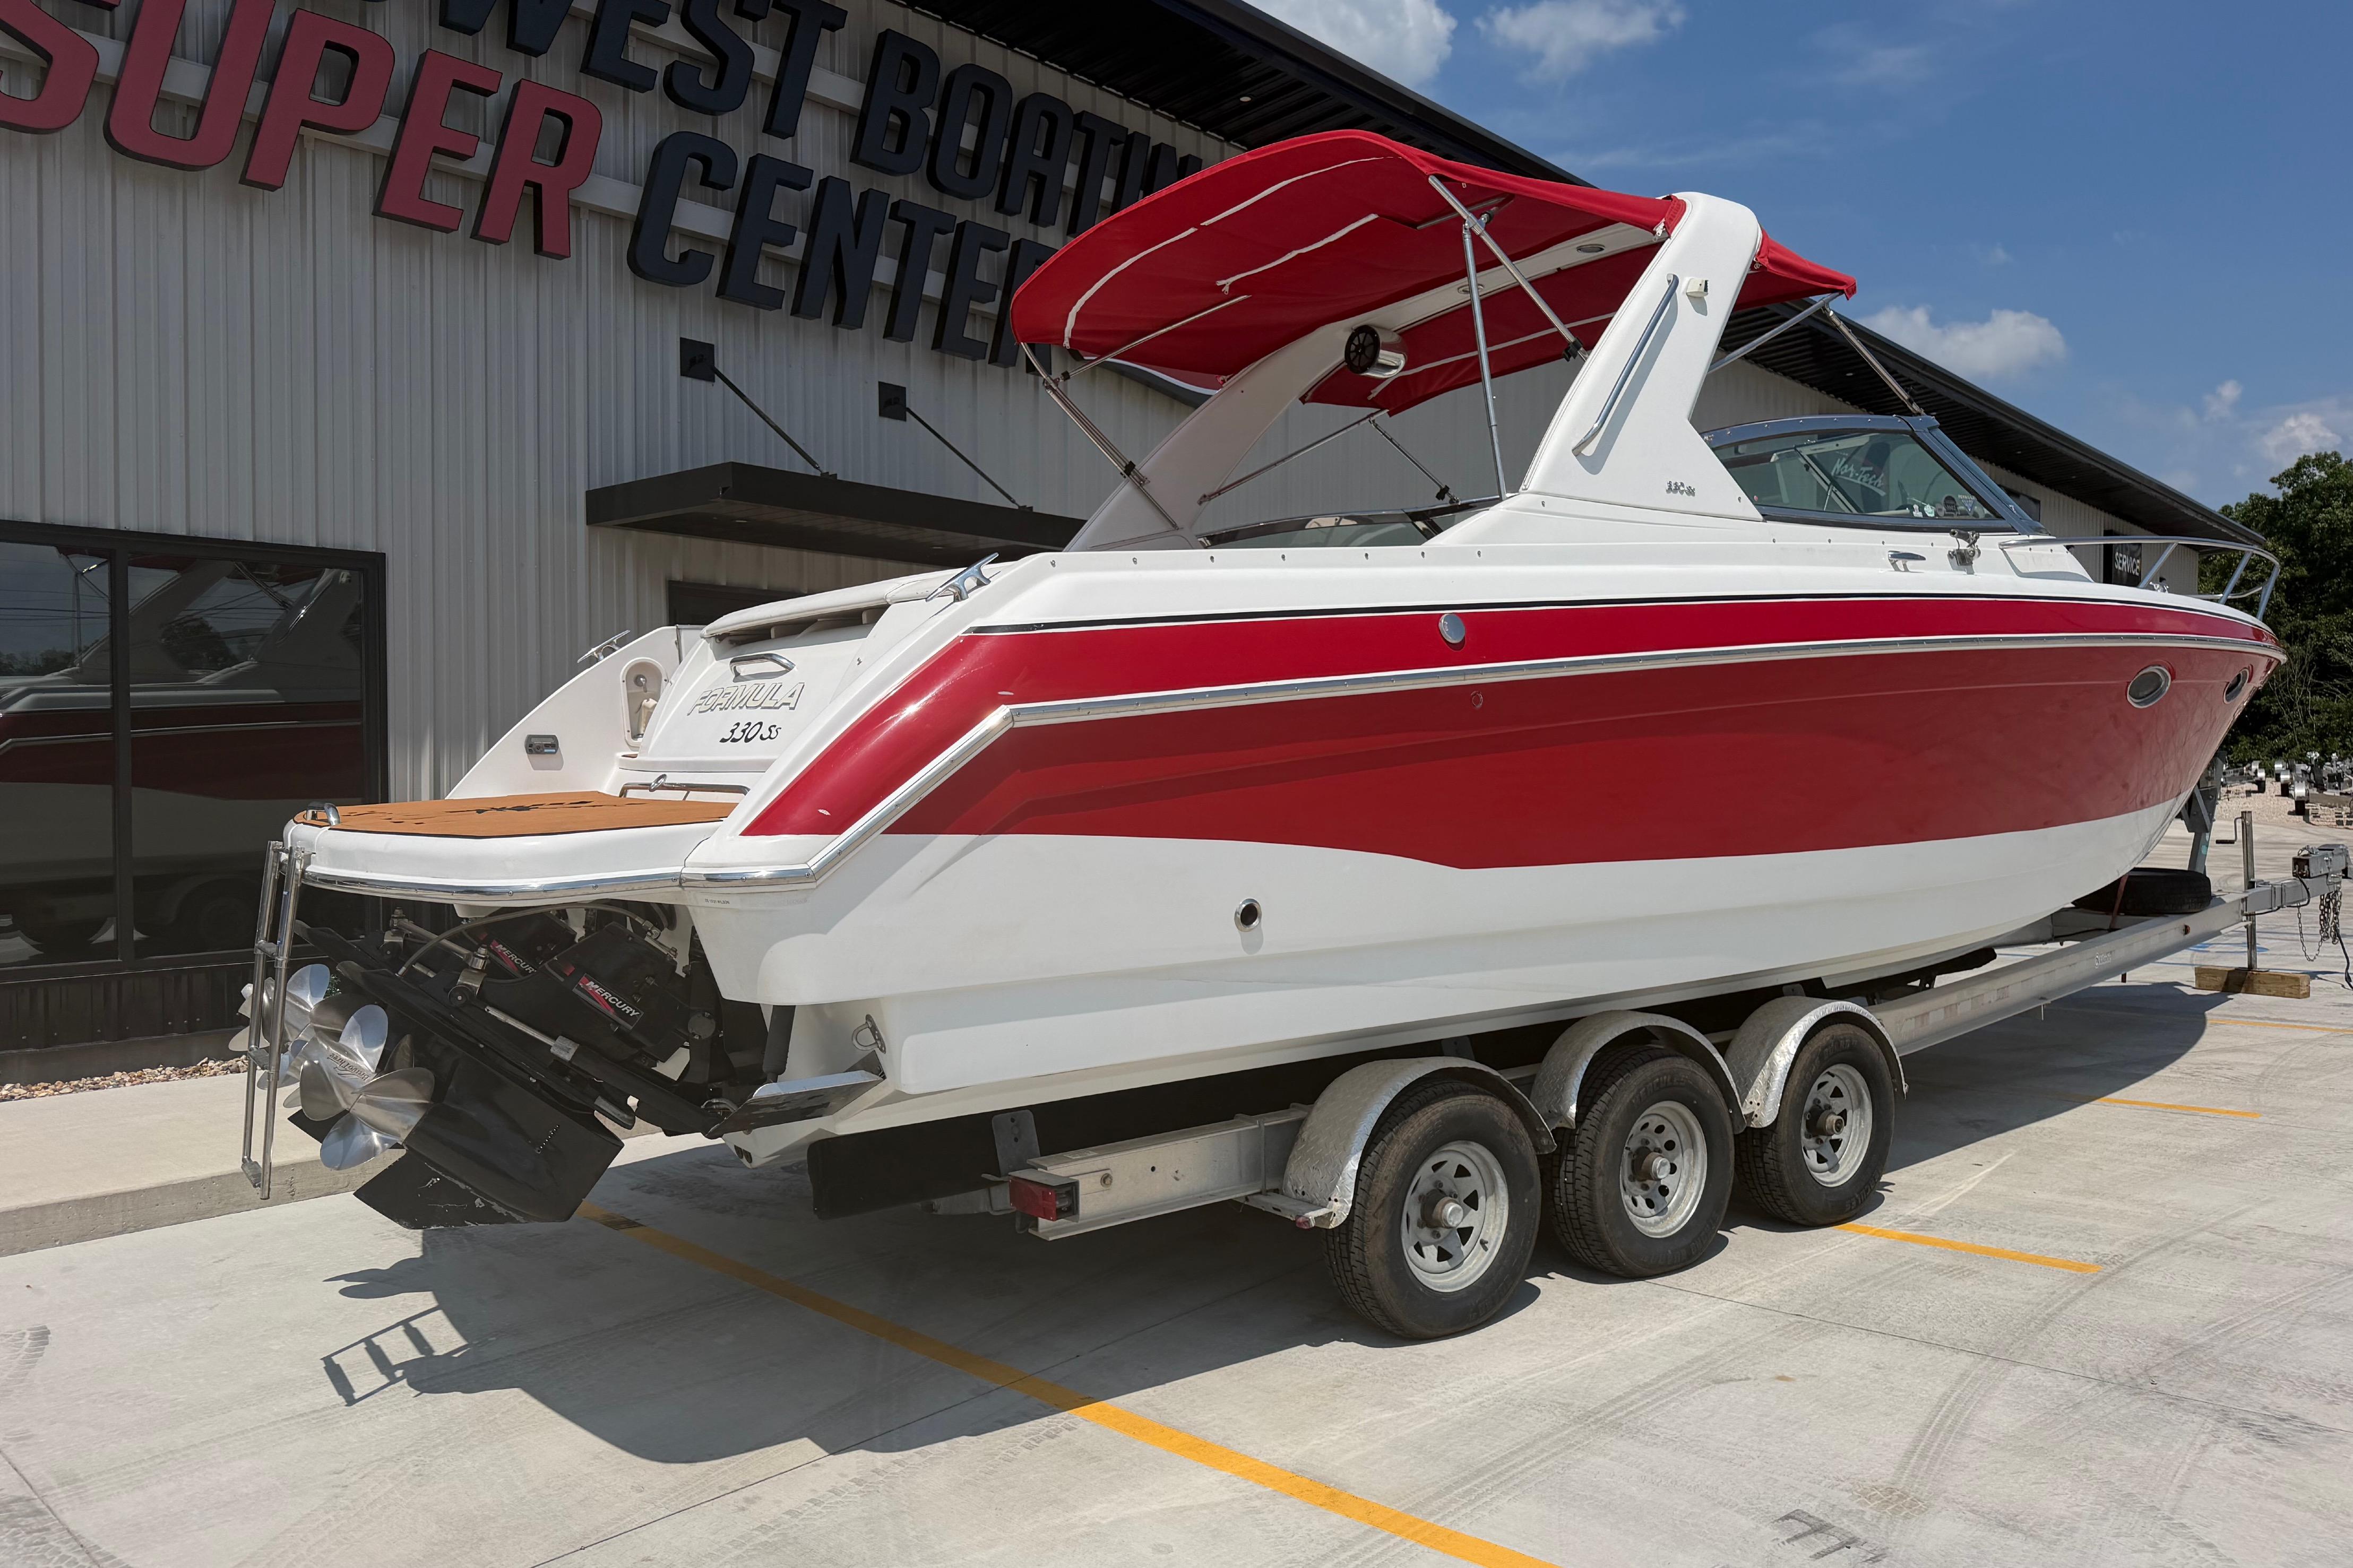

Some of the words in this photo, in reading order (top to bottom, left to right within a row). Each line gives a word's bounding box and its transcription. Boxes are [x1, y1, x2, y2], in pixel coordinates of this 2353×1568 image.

[849, 28, 1203, 238] BOATIN
[2115, 552, 2140, 576] SERVICE
[687, 682, 805, 716] FORMULA
[719, 721, 763, 743] 330
[494, 943, 537, 974] MERCUR
[585, 981, 640, 1017] MERCURY
